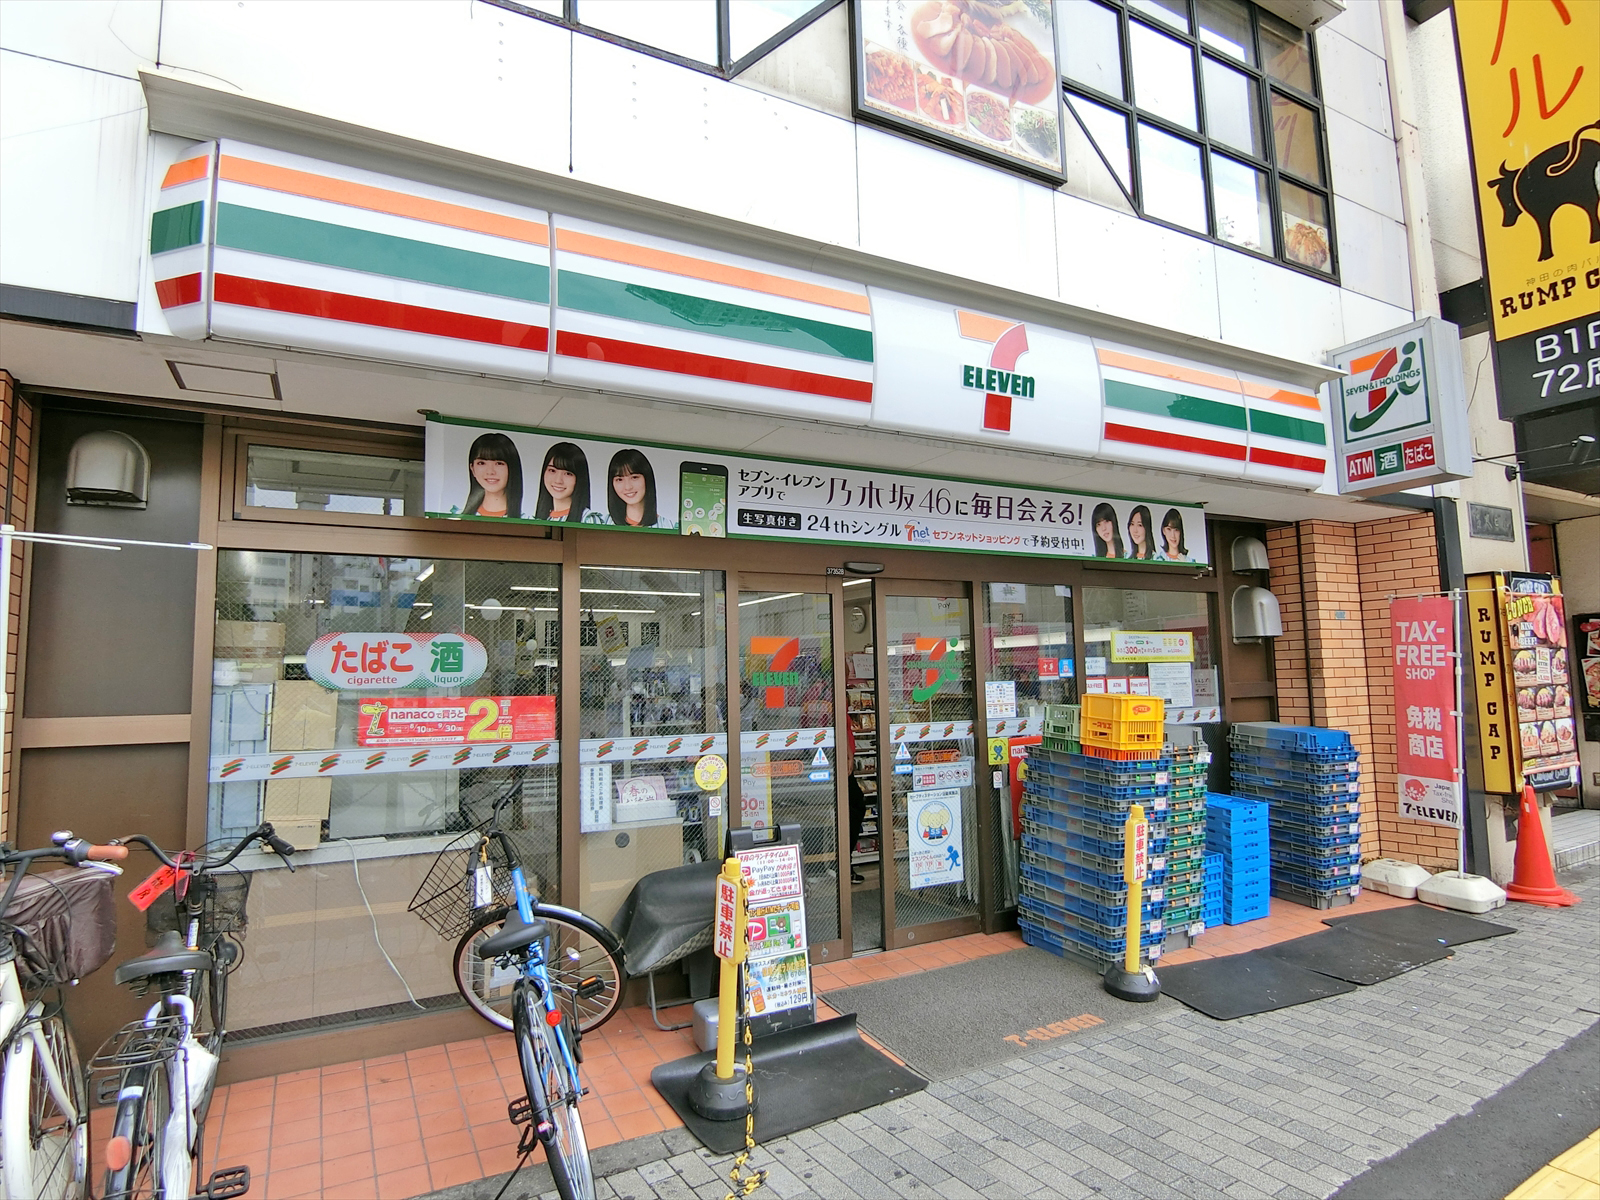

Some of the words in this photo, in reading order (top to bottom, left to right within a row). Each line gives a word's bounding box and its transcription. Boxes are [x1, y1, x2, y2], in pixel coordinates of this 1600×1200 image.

[1500, 276, 1577, 318] RUMP
[1379, 368, 1421, 387] HOLDINGS
[1380, 450, 1397, 470] 酒
[1405, 443, 1433, 464] たばこ
[1349, 456, 1373, 477] ATM
[738, 484, 786, 500] アプリで
[742, 512, 798, 528] 生写真付き
[1505, 596, 1534, 621] LUNCH
[1396, 620, 1445, 643] TAX-
[330, 640, 415, 674] たばこ
[430, 641, 464, 674] 酒
[1395, 644, 1446, 667] FREE
[346, 674, 398, 686] cigarette
[433, 674, 465, 685] liquor
[1405, 668, 1436, 681] SHOP
[1477, 608, 1496, 687] RUMP
[1487, 702, 1501, 760] CAP
[390, 708, 464, 720] nanacoで買うと
[1406, 705, 1442, 731] 免税
[1408, 733, 1444, 760] 商店
[629, 784, 648, 797] 春の
[1135, 824, 1145, 880] 駐車禁止
[718, 884, 734, 958] 駐車禁止
[790, 992, 807, 1004] 129円
